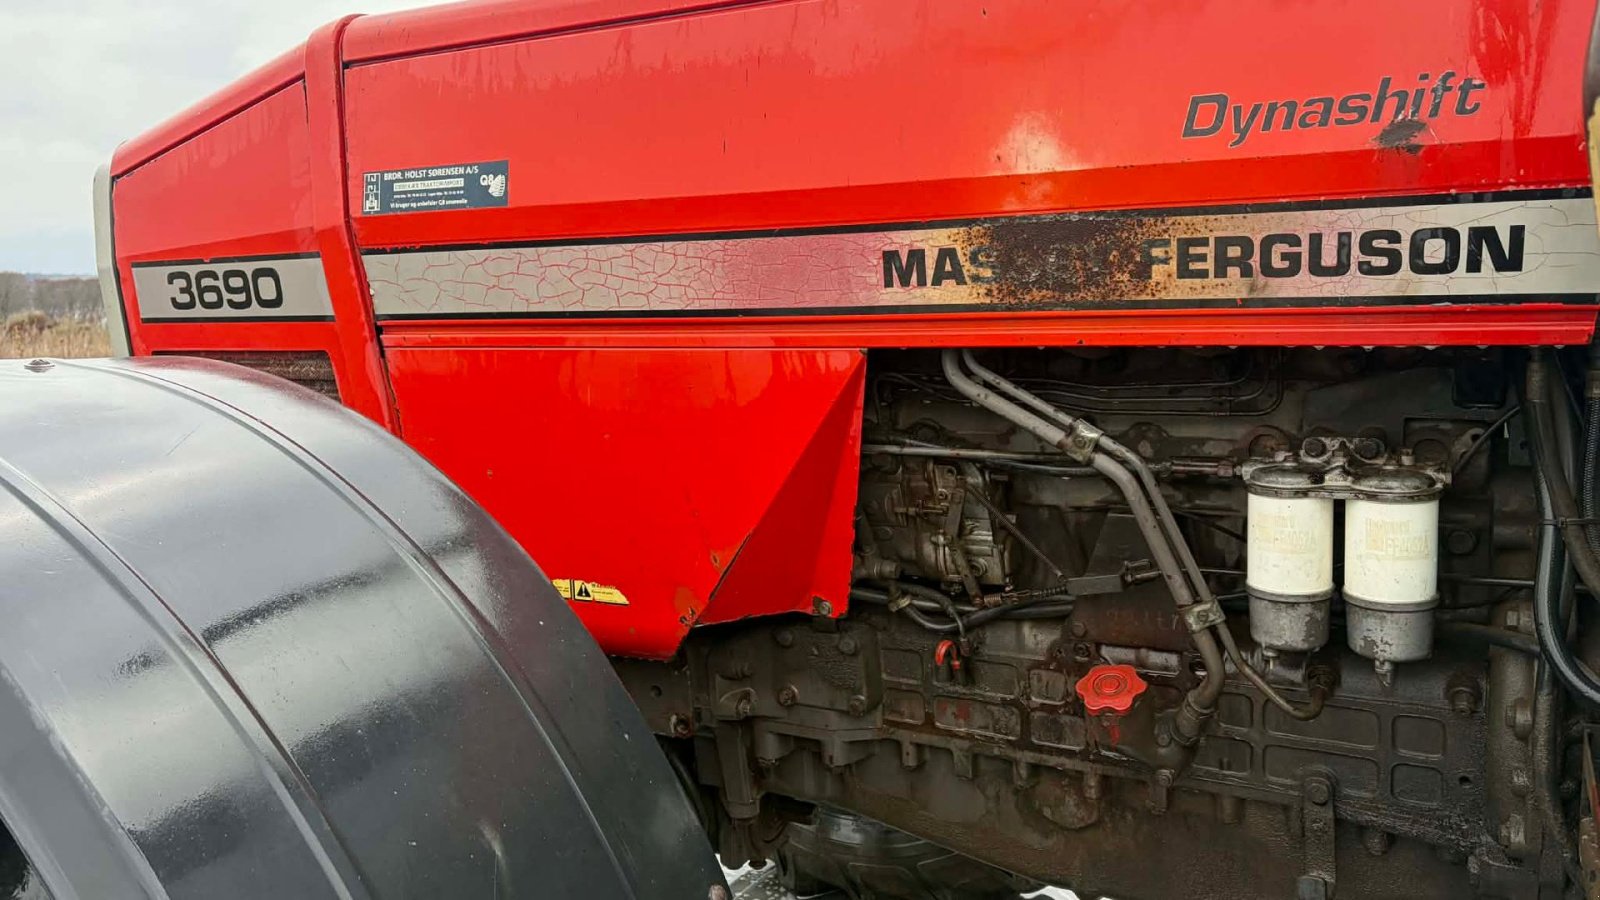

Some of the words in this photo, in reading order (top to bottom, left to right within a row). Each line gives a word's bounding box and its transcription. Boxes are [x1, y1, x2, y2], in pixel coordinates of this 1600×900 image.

[1182, 71, 1485, 148] Dynashift
[405, 169, 427, 179] HOLST
[465, 165, 479, 174] A/S
[480, 174, 494, 186] Q8
[1139, 224, 1526, 281] FERGUSON
[167, 267, 284, 310] 3690
